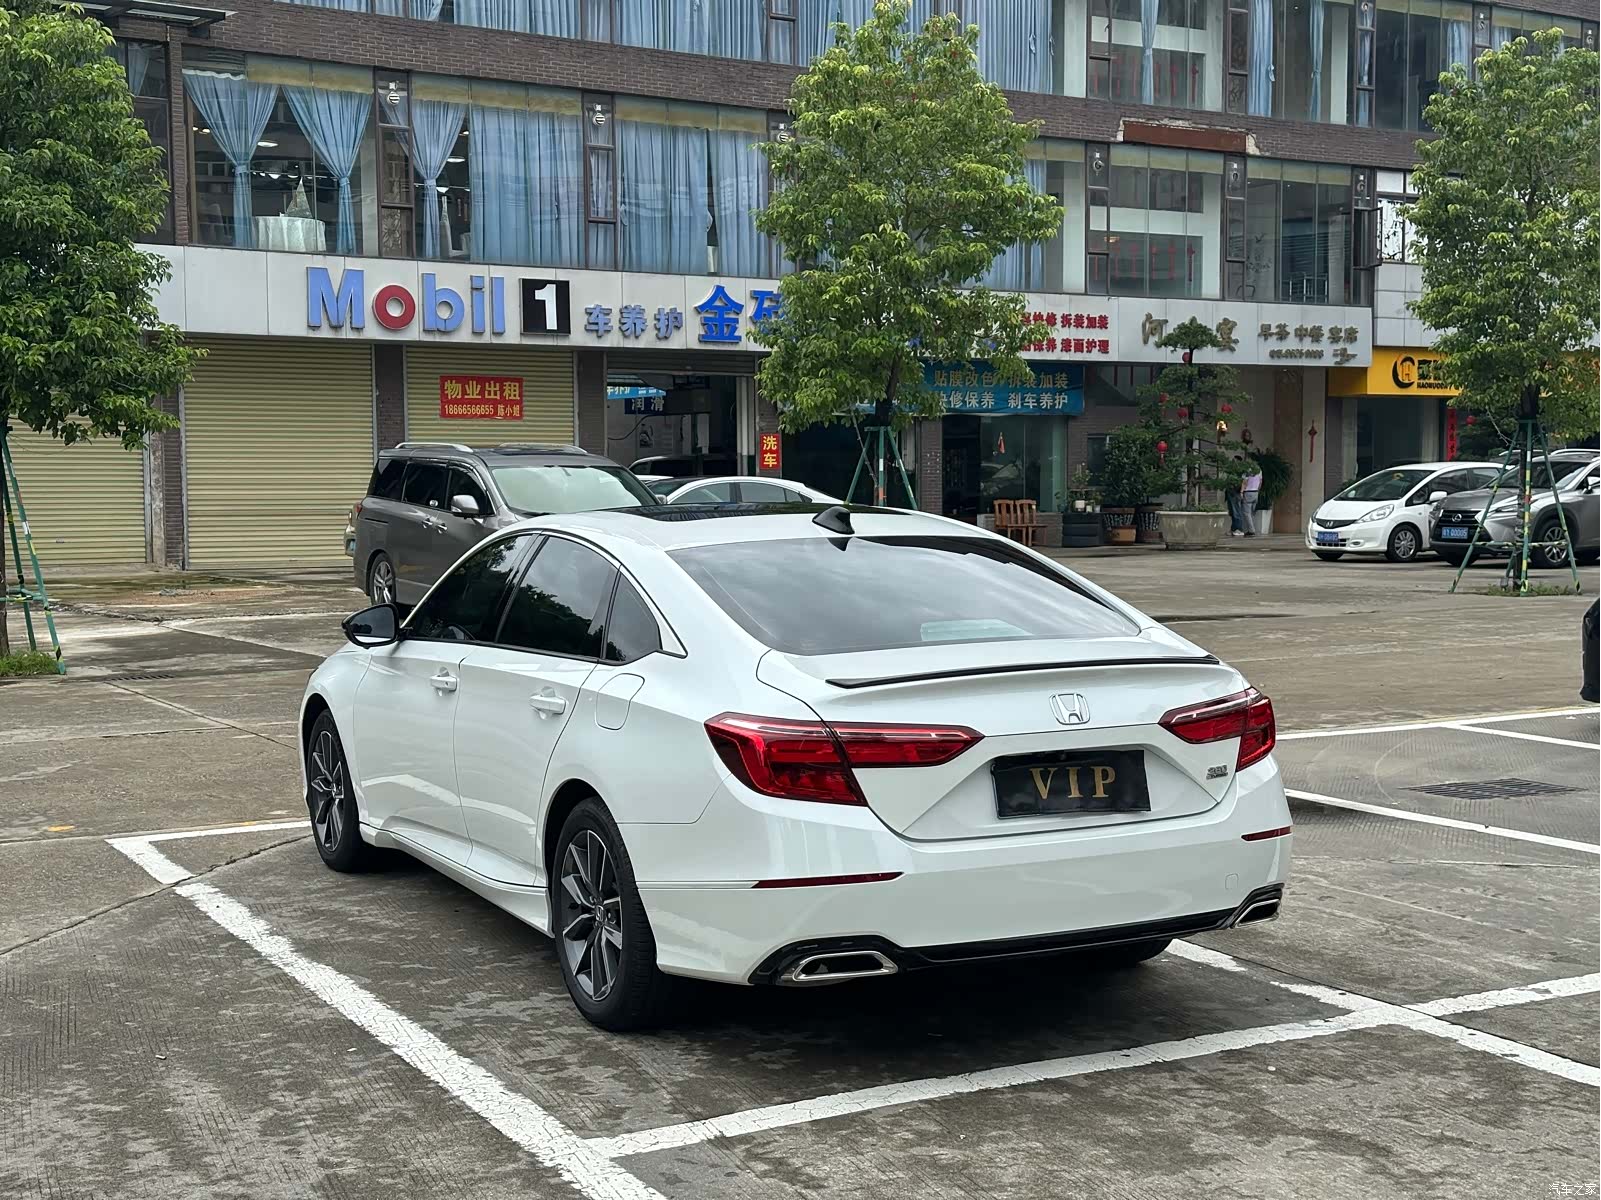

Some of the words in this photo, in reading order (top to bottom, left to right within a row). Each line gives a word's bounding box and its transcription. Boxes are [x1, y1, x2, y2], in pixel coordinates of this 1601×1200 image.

[306, 266, 505, 334] Mobil
[530, 280, 561, 332] 1
[584, 304, 684, 341] 车养护
[1061, 313, 1109, 330] 拆装加装
[1060, 337, 1110, 354] 漆面护理
[934, 370, 994, 388] 贴膜改色
[1009, 371, 1070, 389] 拆装加装
[444, 380, 520, 400] 物业出租
[1008, 391, 1068, 409] 刹车养护
[497, 404, 520, 416] 陈小姐
[763, 435, 778, 468] 洗车
[1029, 765, 1116, 800] VIP
